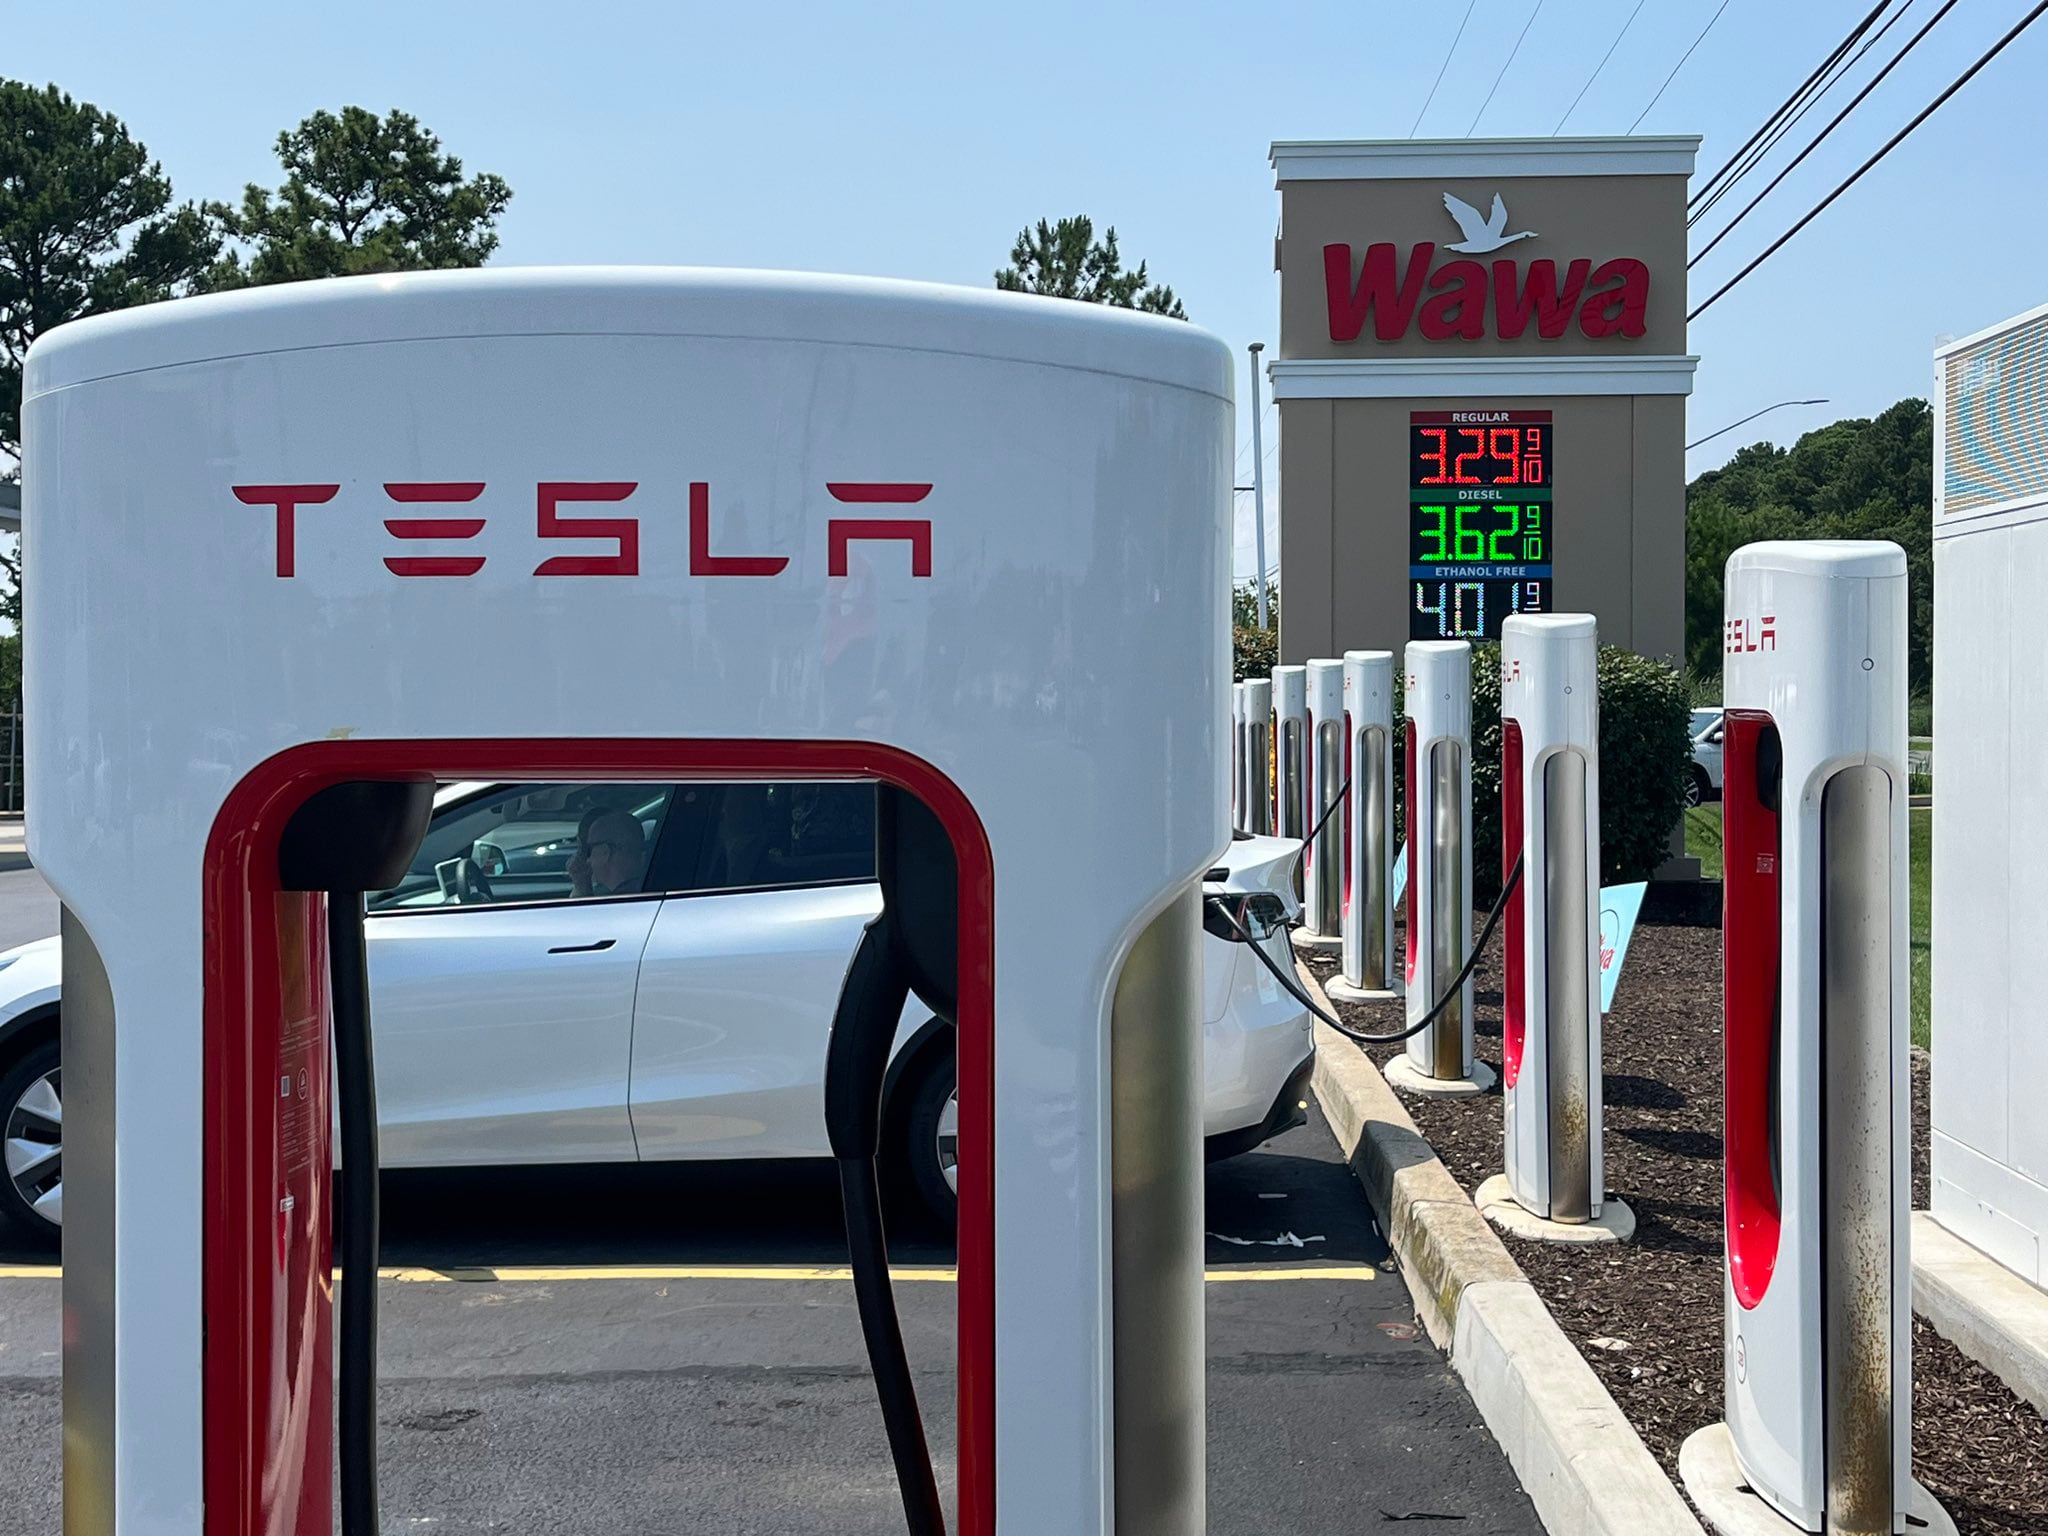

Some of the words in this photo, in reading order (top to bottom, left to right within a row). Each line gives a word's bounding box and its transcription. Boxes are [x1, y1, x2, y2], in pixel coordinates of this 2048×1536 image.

[1323, 241, 1650, 343] Wawa
[1452, 412, 1510, 423] REGULAR
[1419, 428, 1520, 484] 3.29
[1458, 490, 1503, 500] DIESEL
[232, 482, 934, 578] TESLA
[1419, 505, 1520, 561] 3.62
[1435, 566, 1493, 577] ETHANOL
[1496, 566, 1526, 577] FREE
[1727, 615, 1777, 654] ESLA
